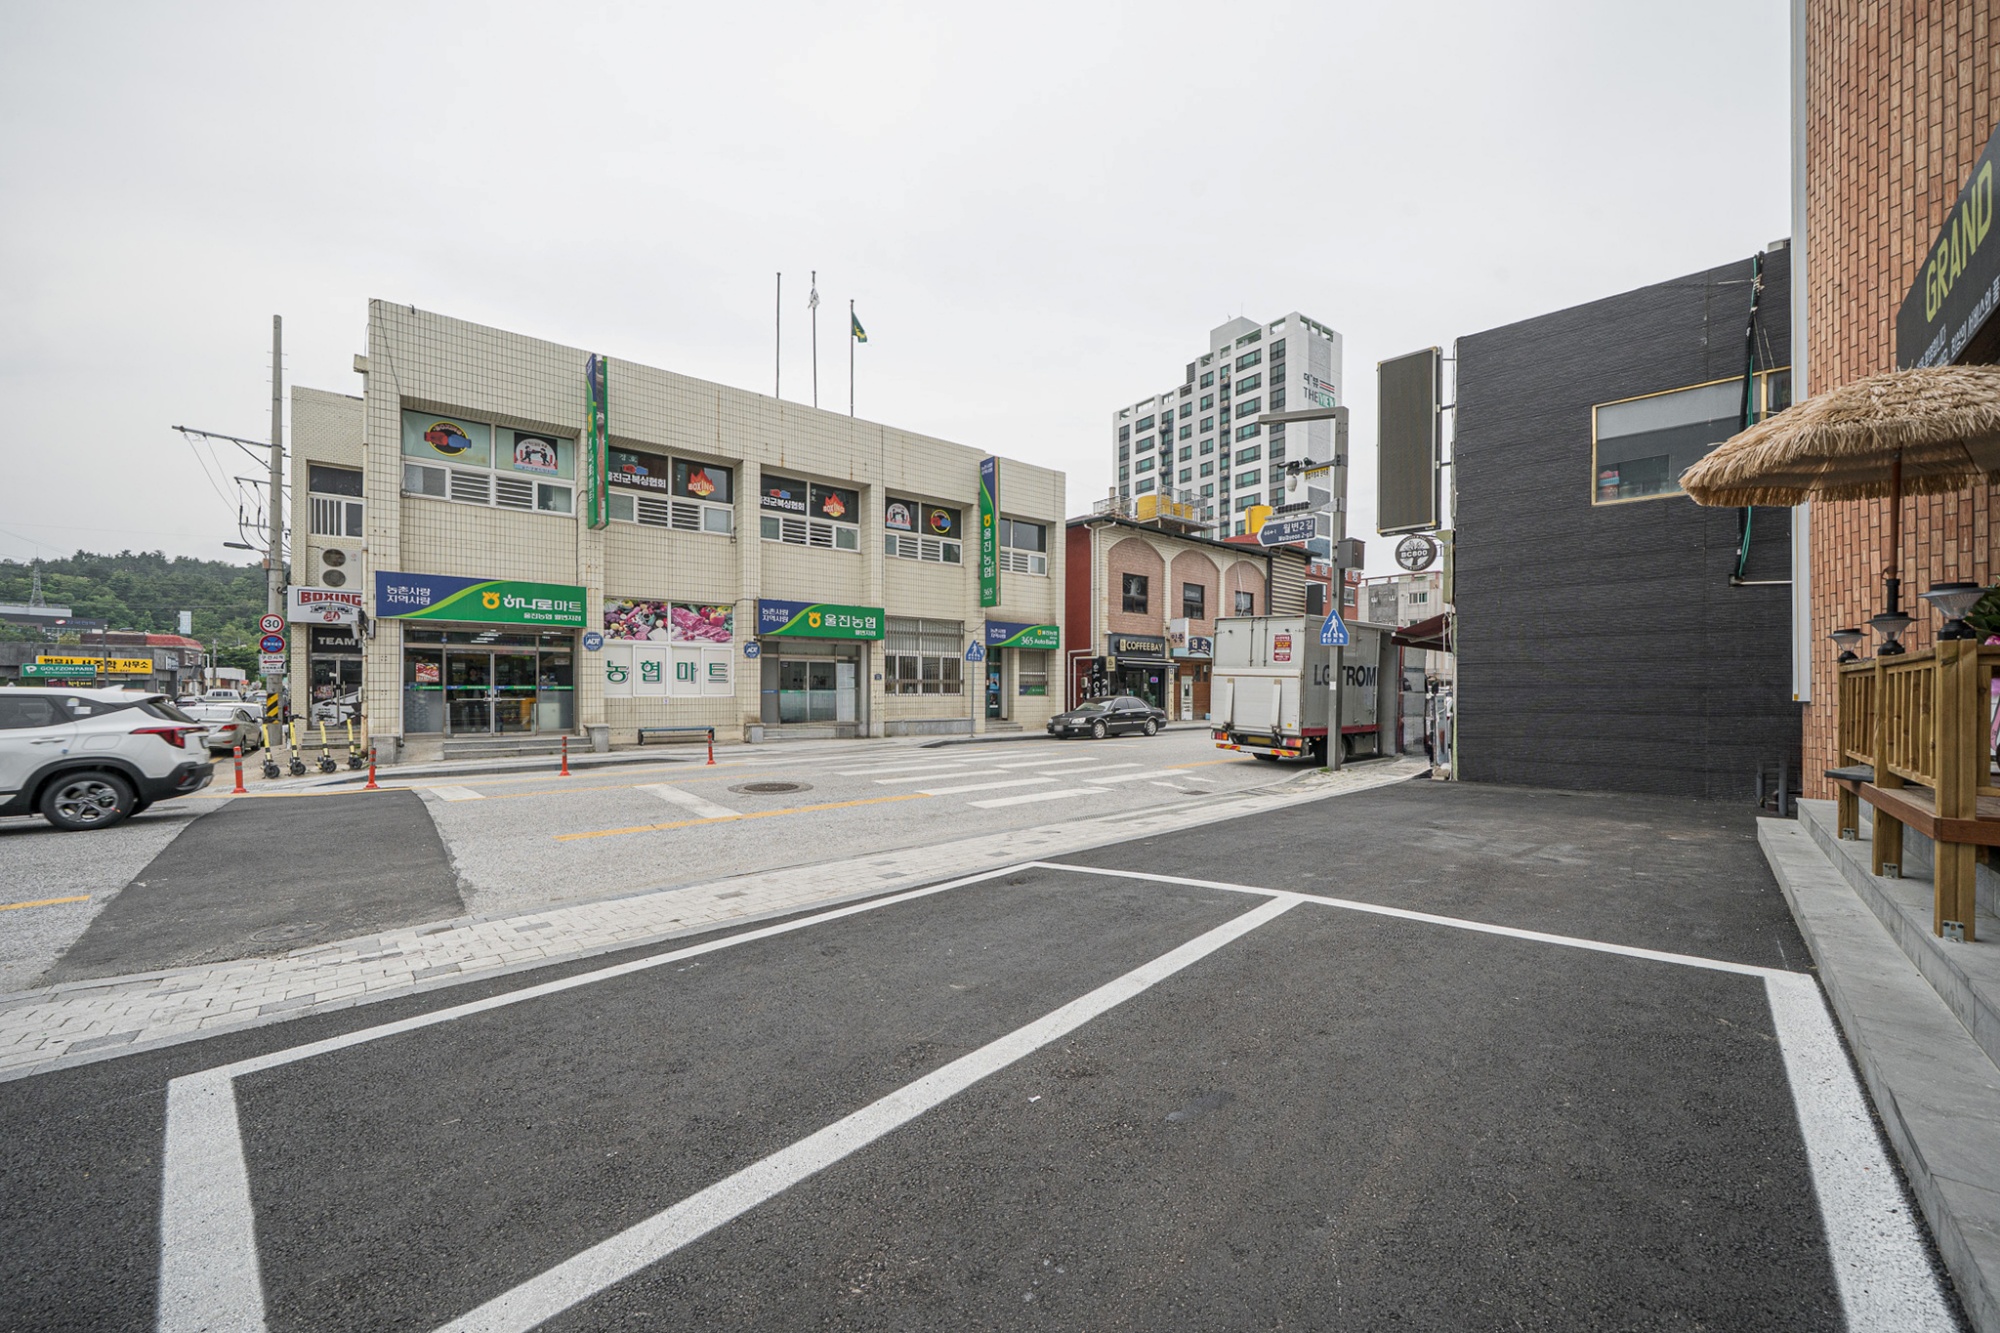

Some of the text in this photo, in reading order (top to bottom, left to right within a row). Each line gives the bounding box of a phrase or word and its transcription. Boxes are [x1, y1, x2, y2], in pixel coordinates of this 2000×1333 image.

[1927, 160, 1992, 323] GRAND
[688, 477, 715, 492] BOXING
[1283, 519, 1313, 534] 월변2길
[387, 585, 431, 596] 농촌사랑
[301, 592, 361, 606] BOXING
[387, 594, 431, 605] 지역사랑
[264, 619, 279, 628] 30
[825, 614, 876, 629] 울진농협
[317, 637, 356, 646] TEAM
[1021, 636, 1033, 645] 365
[122, 661, 148, 669] 사무소
[1314, 664, 1330, 686] LG
